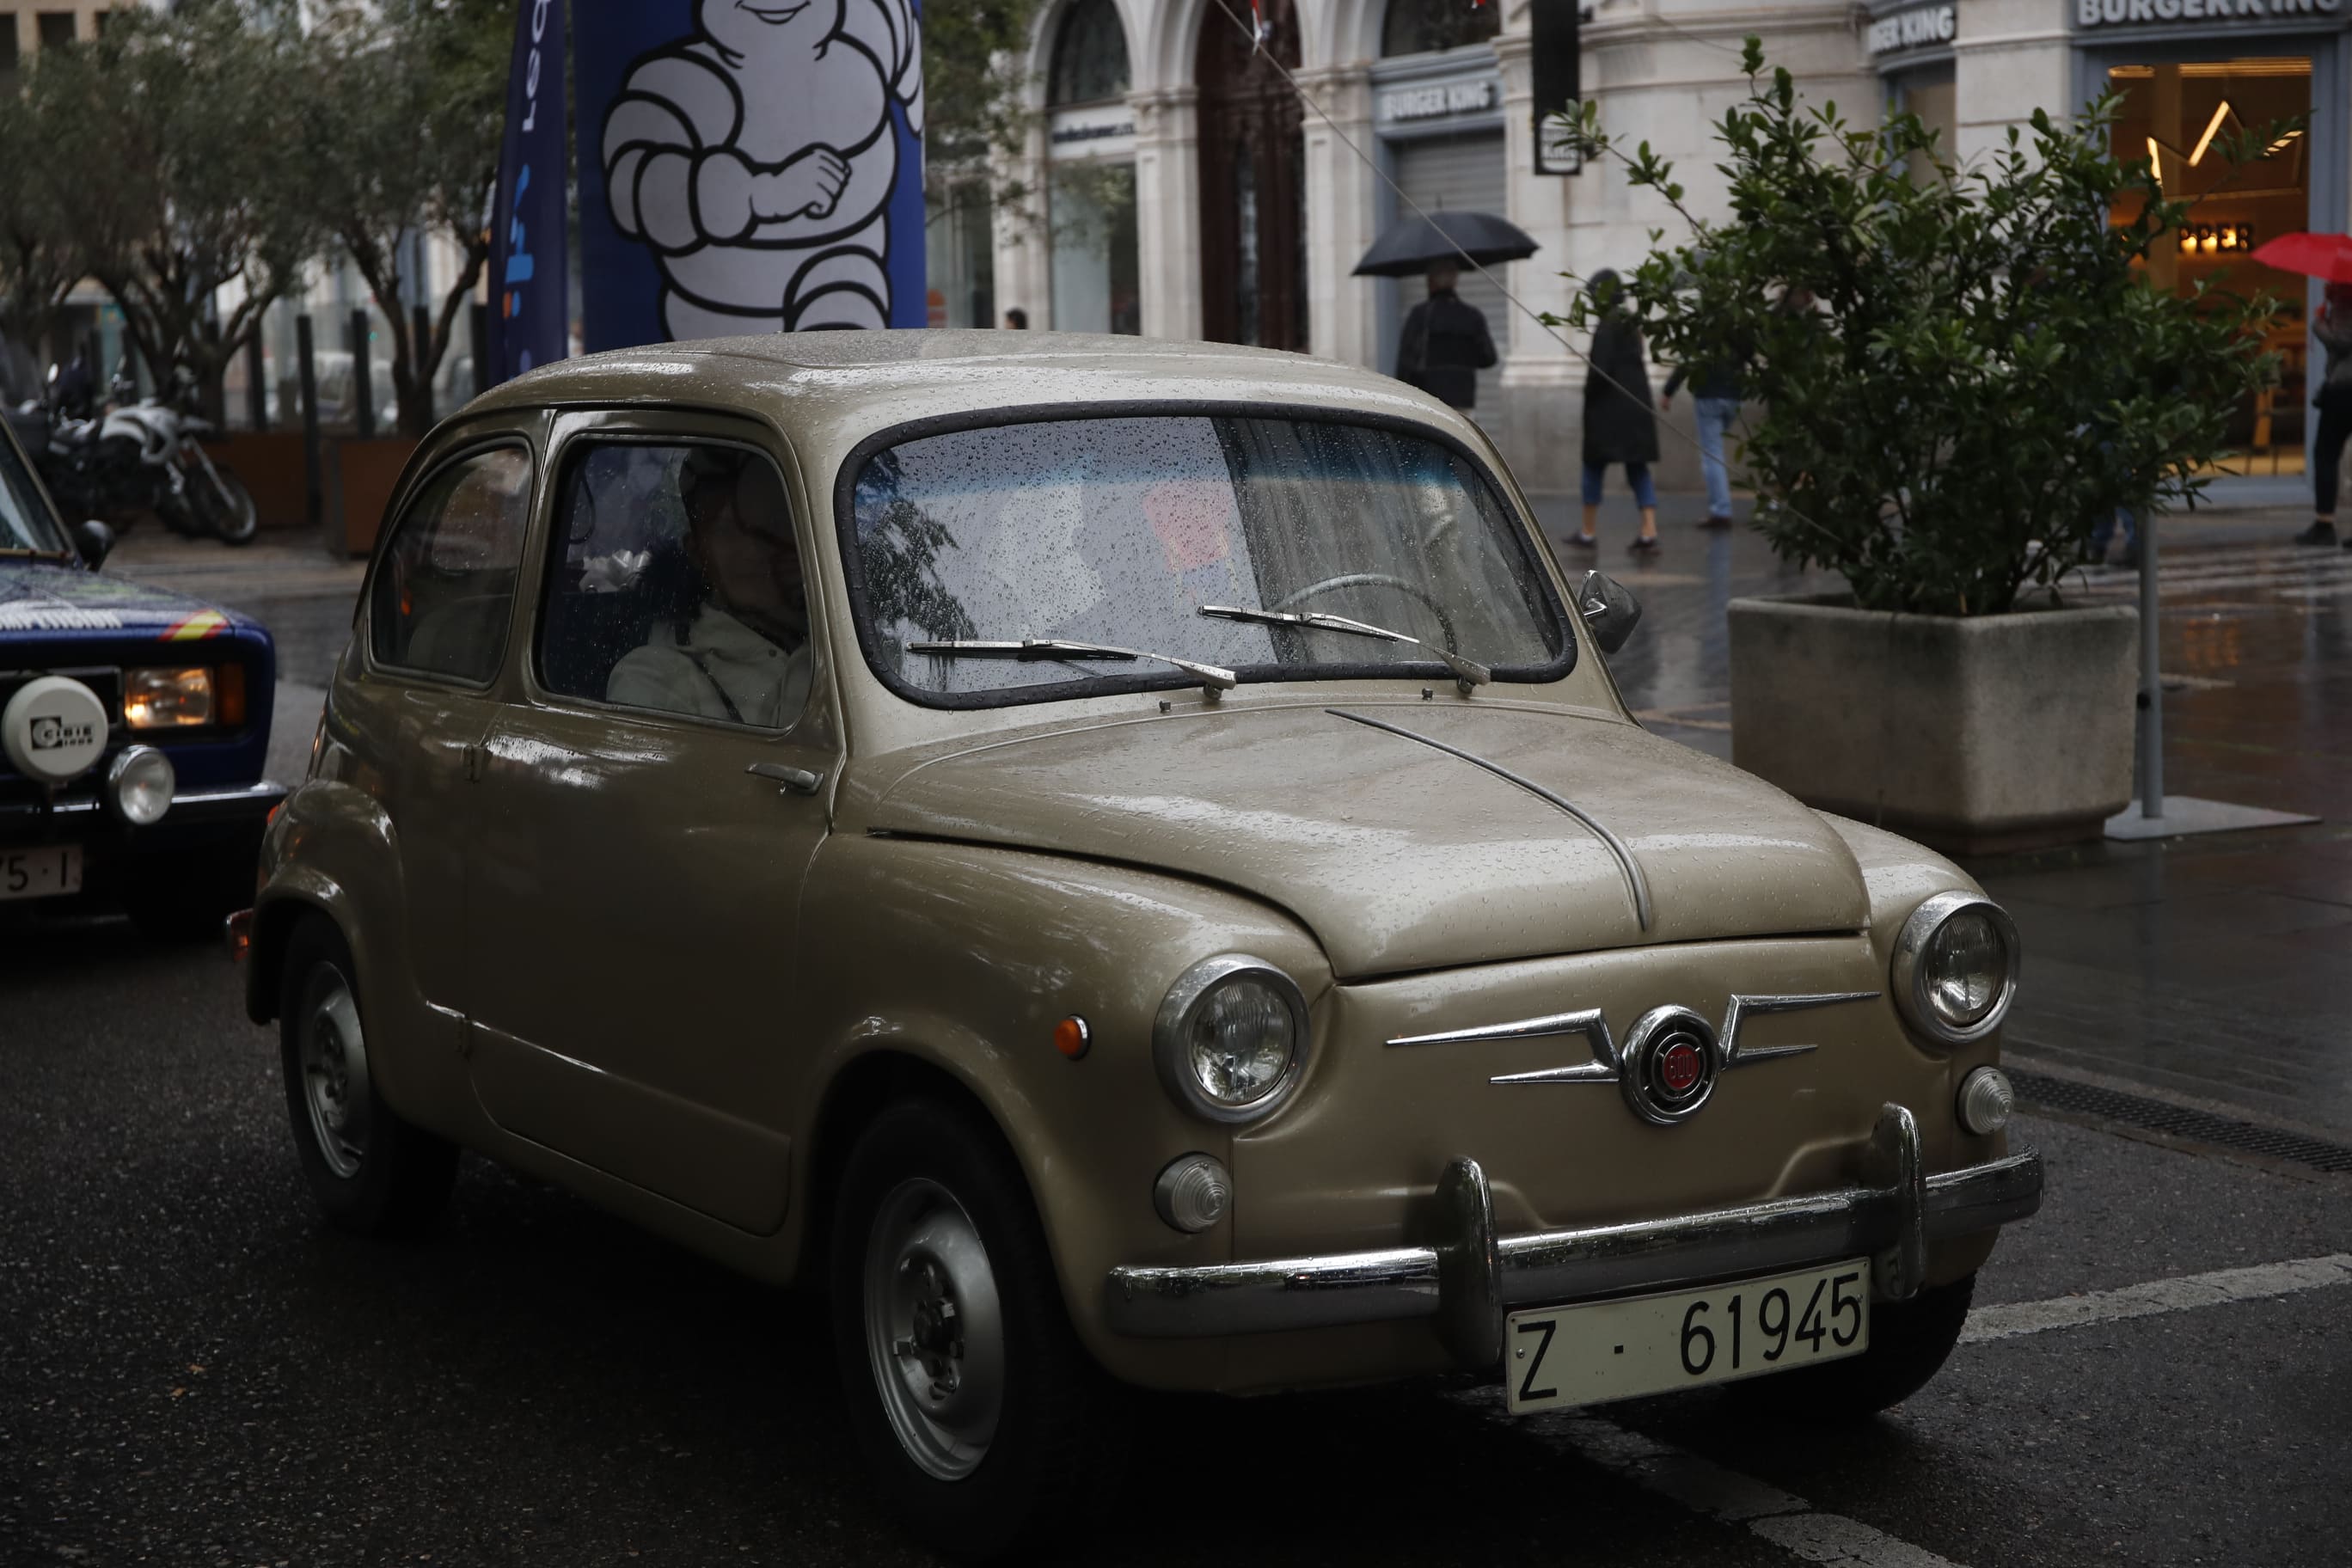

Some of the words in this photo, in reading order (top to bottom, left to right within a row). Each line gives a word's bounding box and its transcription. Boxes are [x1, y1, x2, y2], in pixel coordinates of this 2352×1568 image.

[1901, 6, 1953, 45] KING
[1517, 1320, 1558, 1402] Z
[1679, 1271, 1862, 1375] 61945
